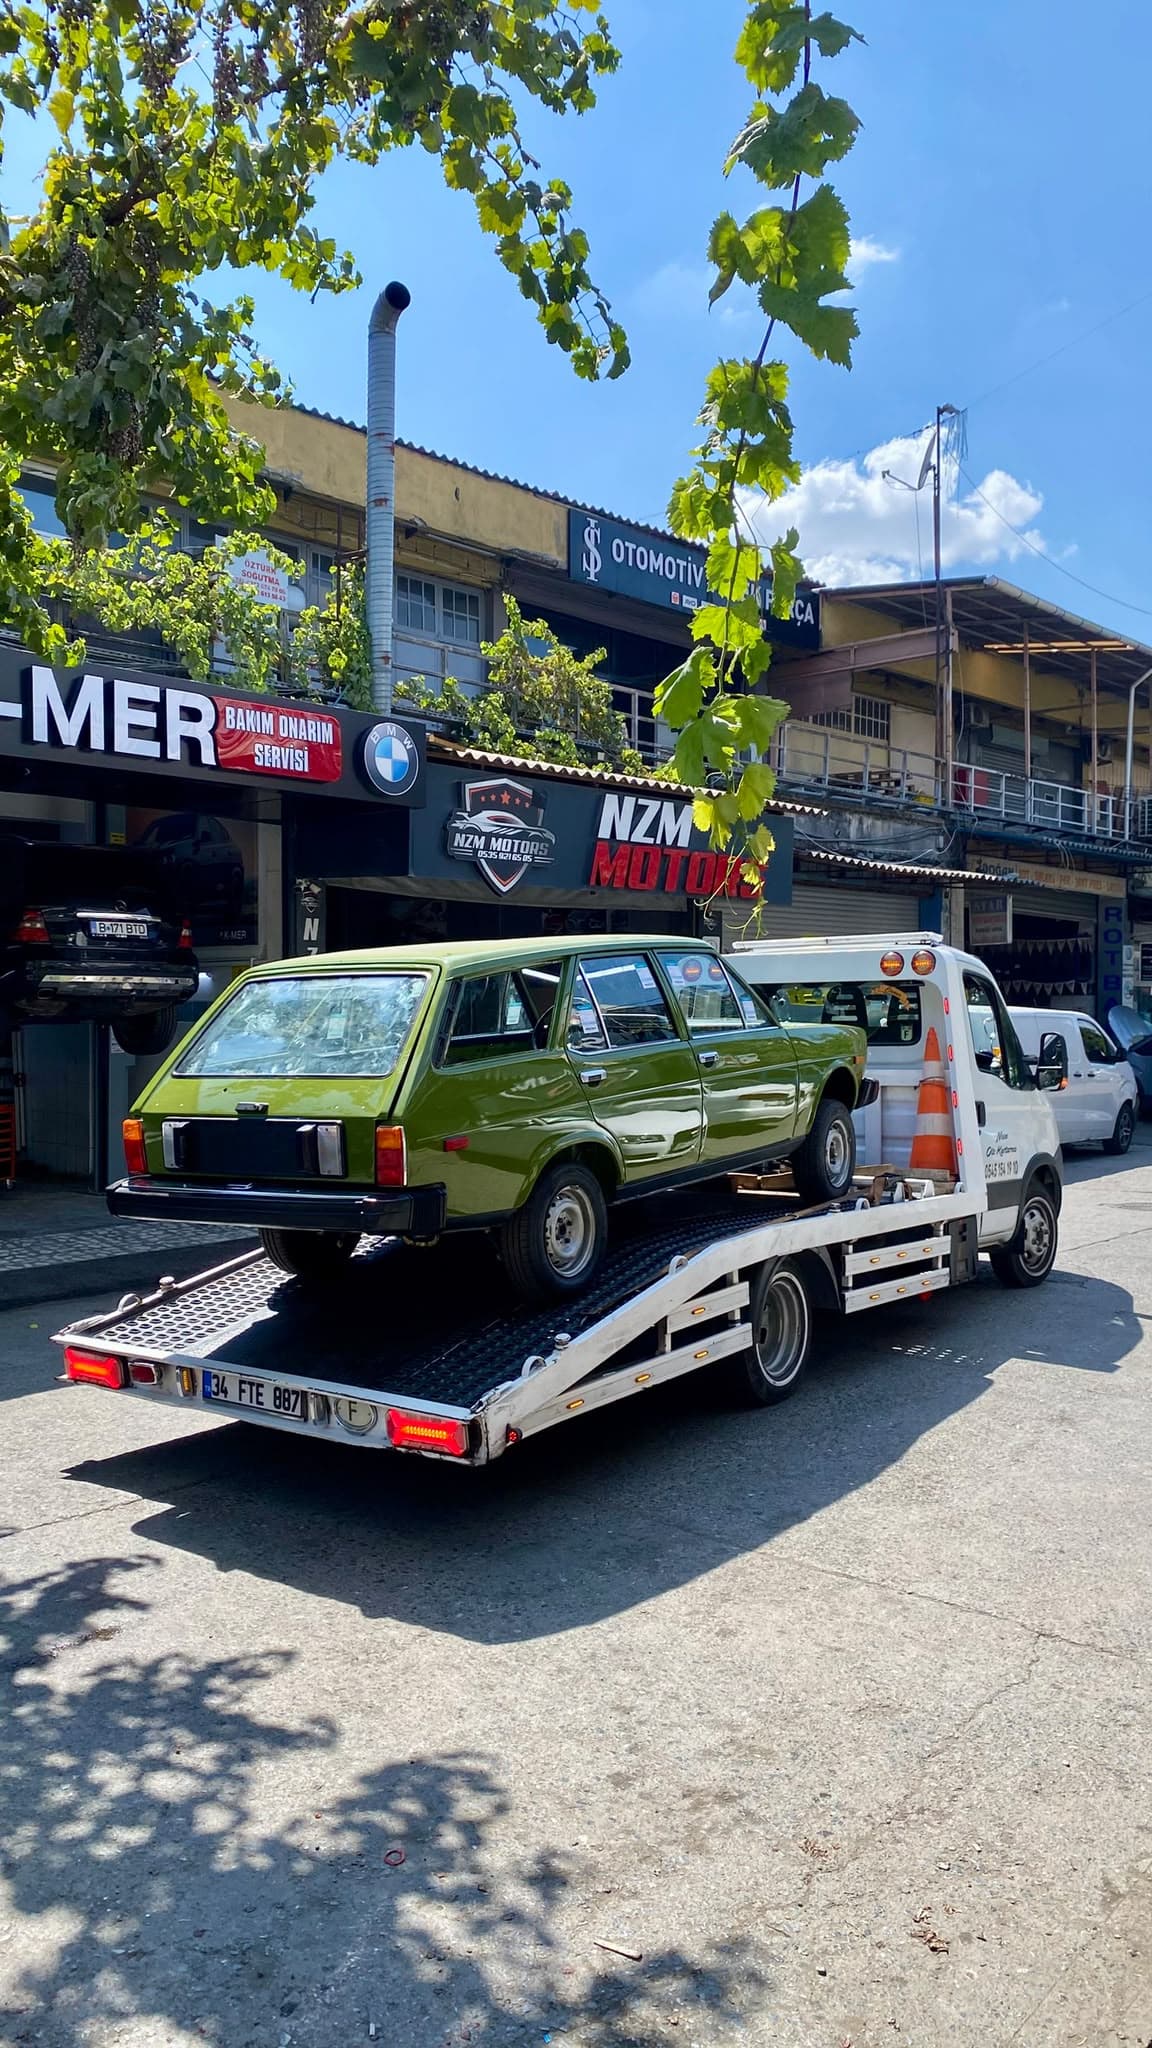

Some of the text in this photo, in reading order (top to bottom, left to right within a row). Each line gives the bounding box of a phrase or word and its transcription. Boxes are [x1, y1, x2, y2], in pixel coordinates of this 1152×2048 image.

[611, 537, 704, 588] OTOMOTİV
[225, 706, 334, 745] BAKIM ONARIM
[254, 743, 309, 773] SERVİSİ
[597, 793, 693, 848] NZM
[453, 833, 550, 856] NZM MOTORS
[477, 850, 498, 860] 0535
[212, 1374, 229, 1398] 34
[238, 1380, 264, 1406] FTE
[273, 1386, 300, 1413] 887
[349, 1401, 358, 1421] F
